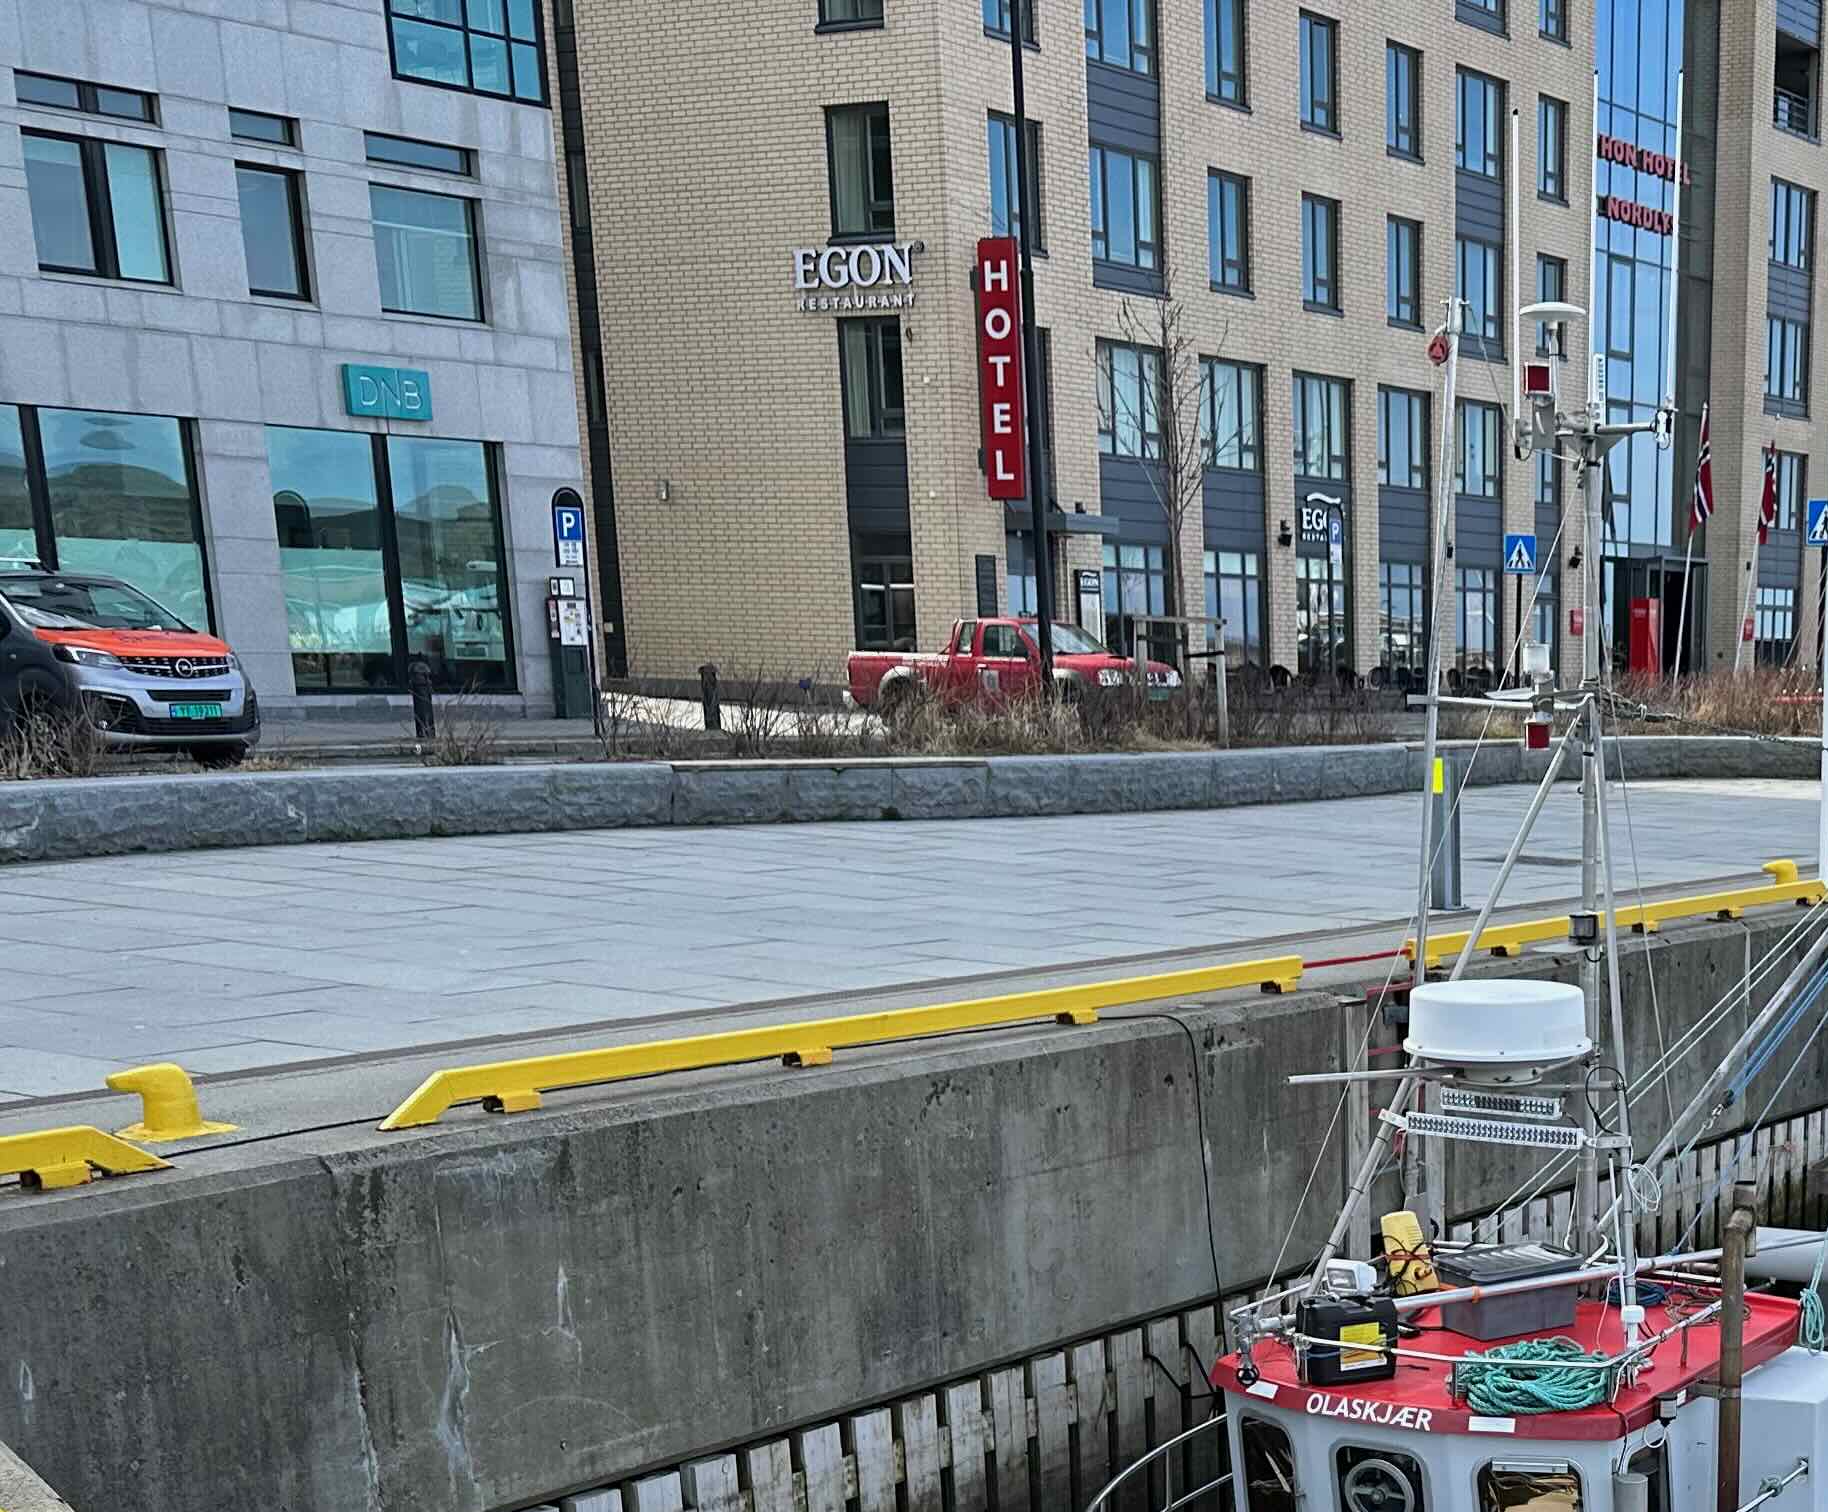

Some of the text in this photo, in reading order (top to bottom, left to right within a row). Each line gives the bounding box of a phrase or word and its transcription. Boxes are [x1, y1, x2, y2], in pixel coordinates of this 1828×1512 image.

[793, 244, 913, 289] EGON
[799, 294, 915, 312] RESTAURANT
[983, 260, 1015, 480] HOTEL
[360, 371, 422, 413] DNB
[562, 512, 575, 537] P
[1306, 1393, 1433, 1432] OLASKJÆR
